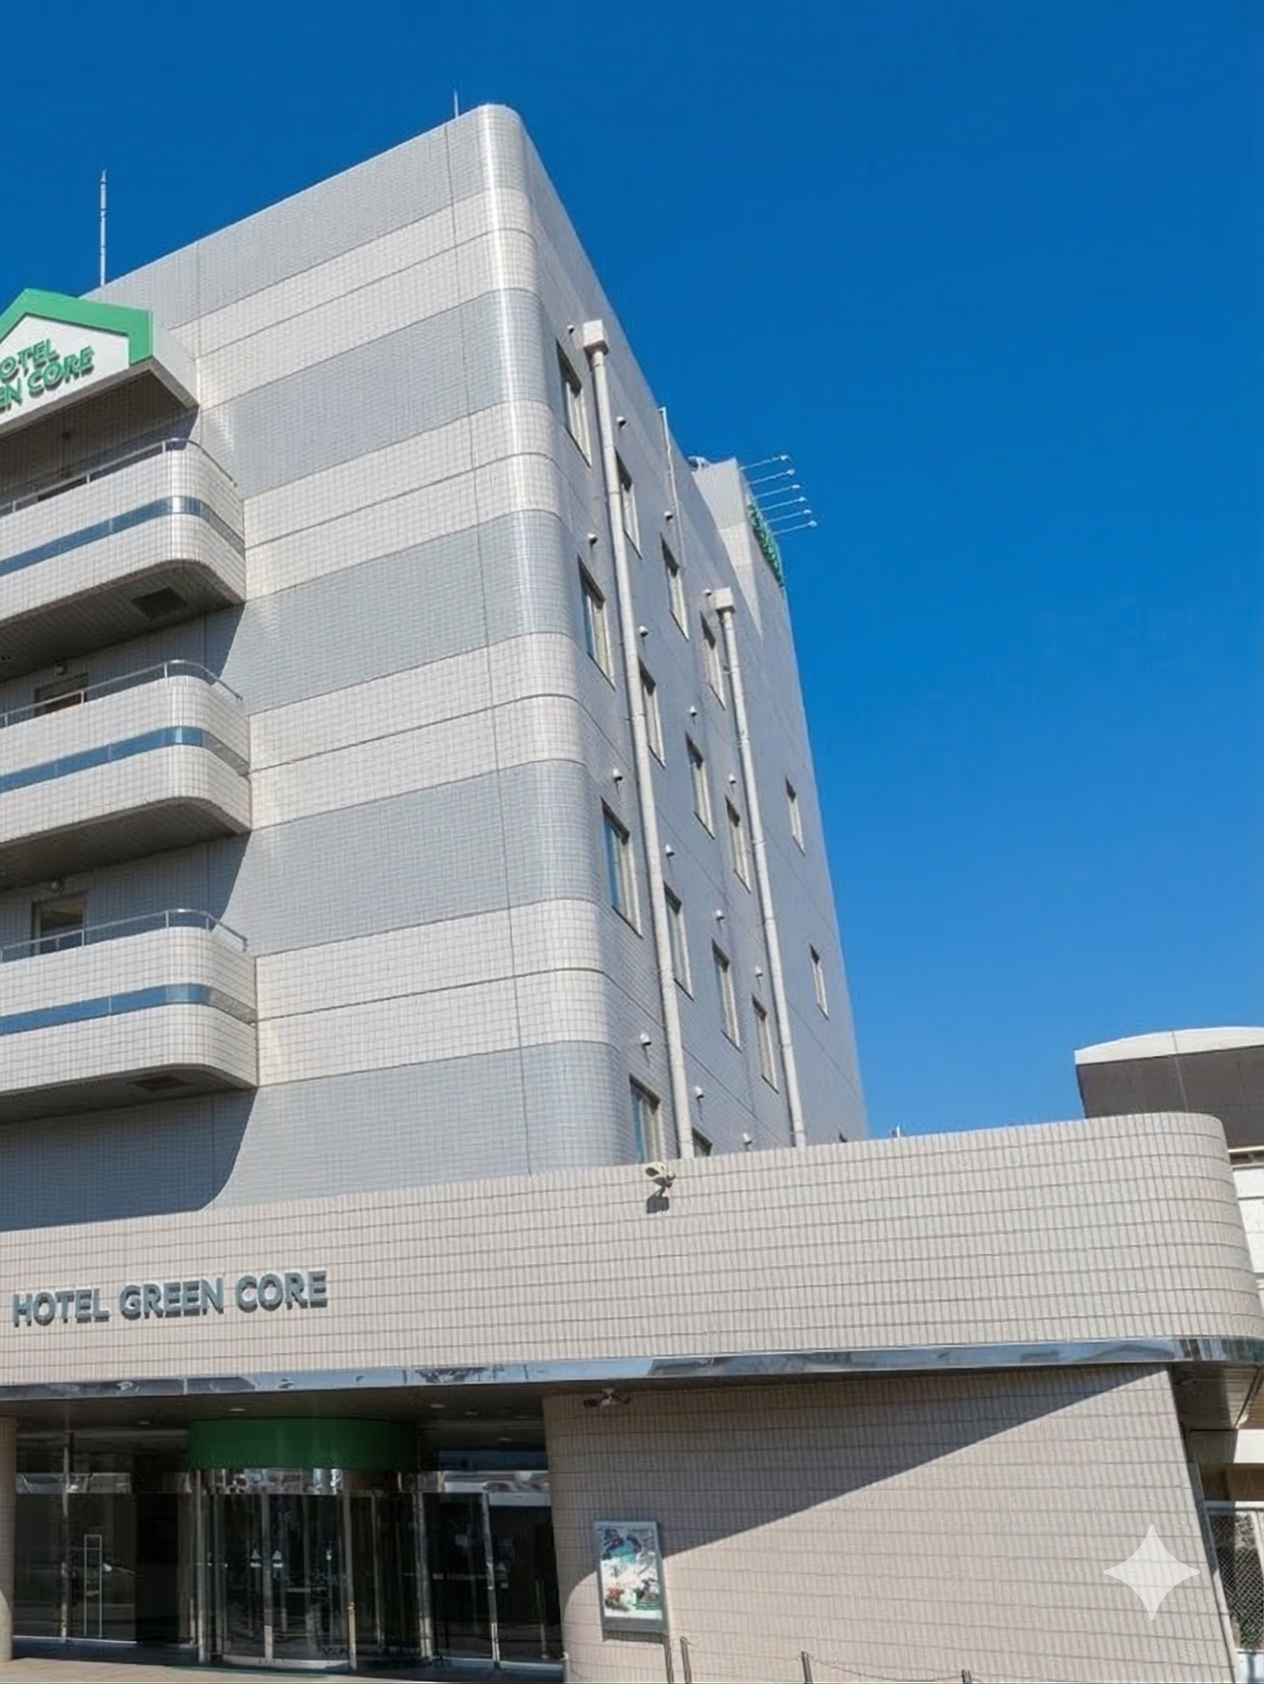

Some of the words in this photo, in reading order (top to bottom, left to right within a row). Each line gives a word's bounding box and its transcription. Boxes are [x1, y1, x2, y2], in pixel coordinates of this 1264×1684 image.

[27, 345, 95, 396] CORE
[12, 1287, 110, 1327] HOTEL
[119, 1276, 225, 1320] GREEN
[235, 1269, 329, 1313] CORE
